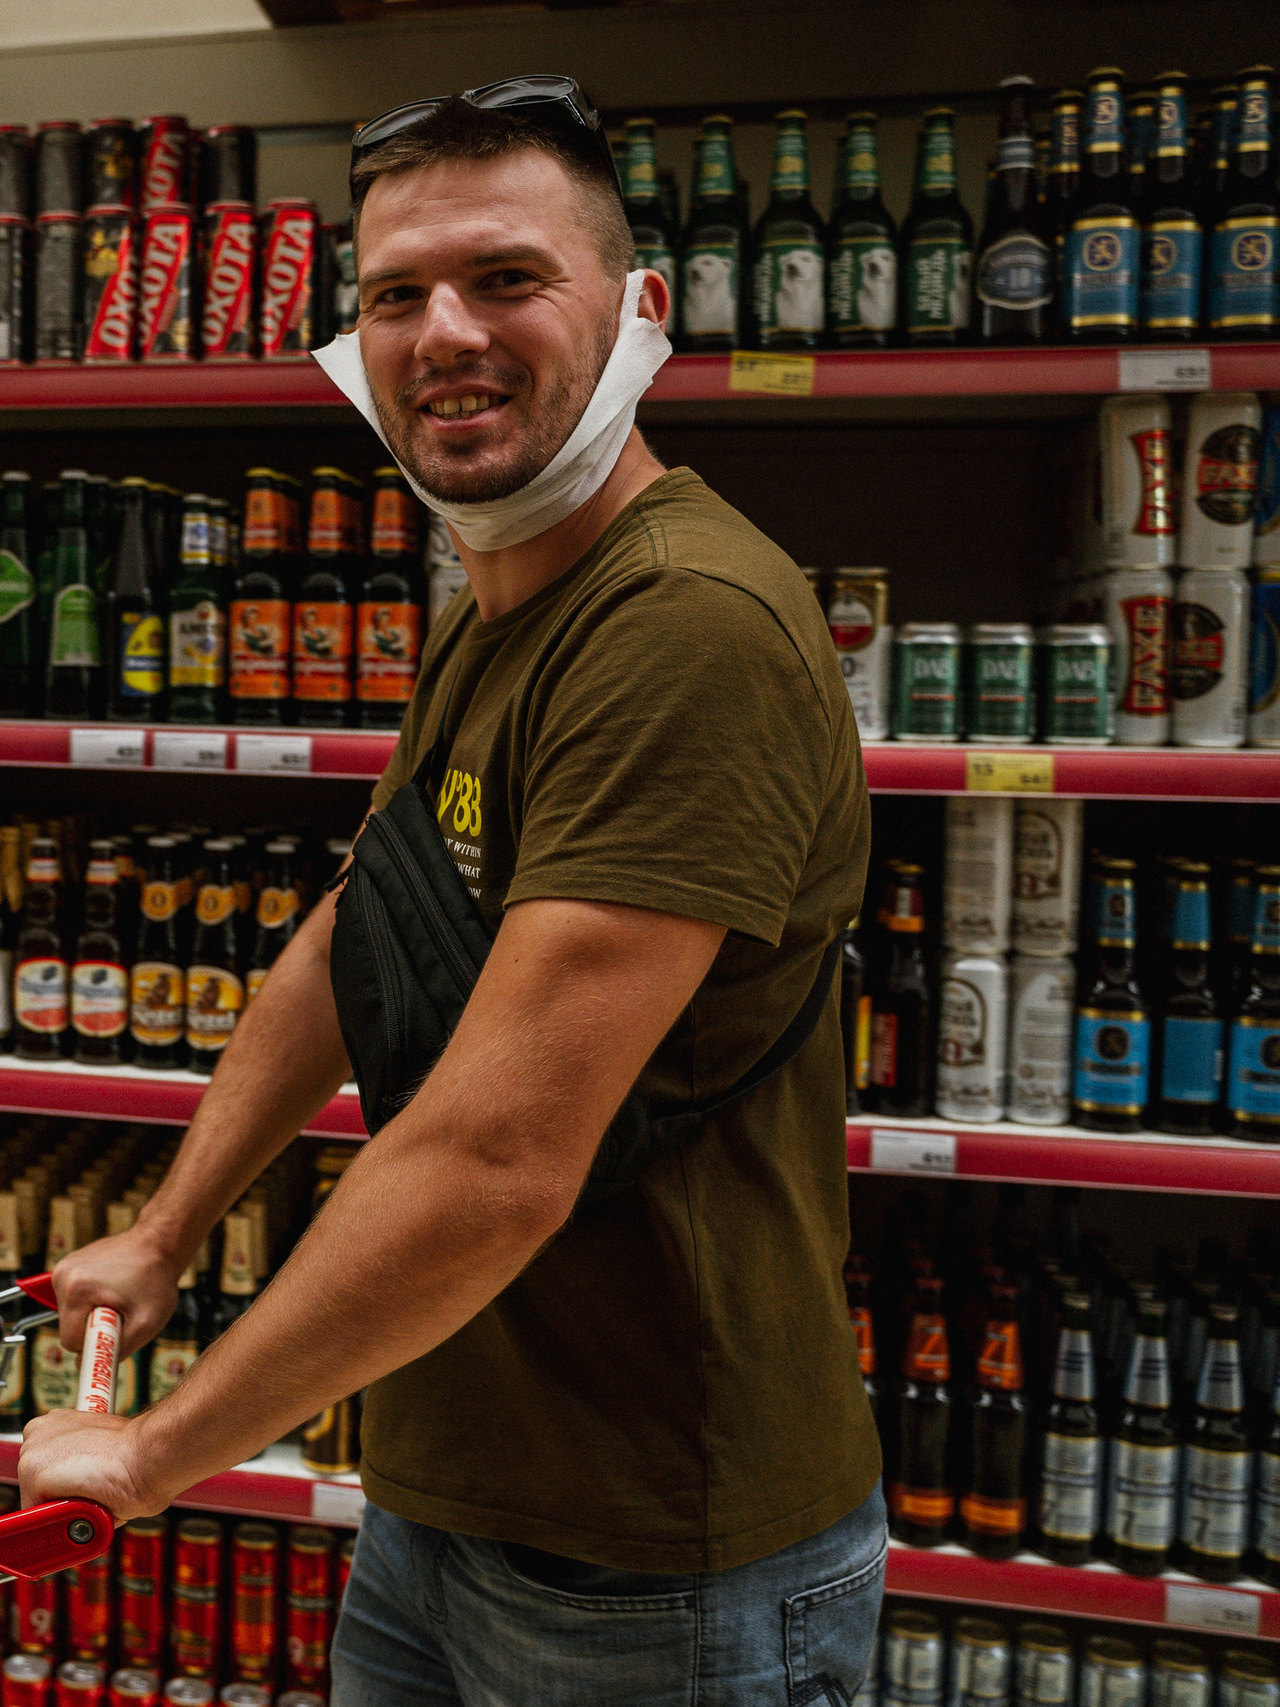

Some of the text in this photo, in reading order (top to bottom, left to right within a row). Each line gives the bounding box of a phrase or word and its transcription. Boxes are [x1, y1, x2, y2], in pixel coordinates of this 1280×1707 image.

[144, 133, 182, 208] ХОТА
[99, 255, 134, 347] ОХО
[202, 223, 255, 346] ОХОТА
[263, 219, 313, 344] ОХОТА
[1132, 604, 1165, 708] FAXE
[454, 841, 482, 859] WITHIN
[457, 862, 481, 879] WHAT
[467, 886, 482, 899] OW
[91, 1331, 116, 1396] ГИПЕРМАРКЕТ
[85, 1394, 109, 1414] ЫЙ
